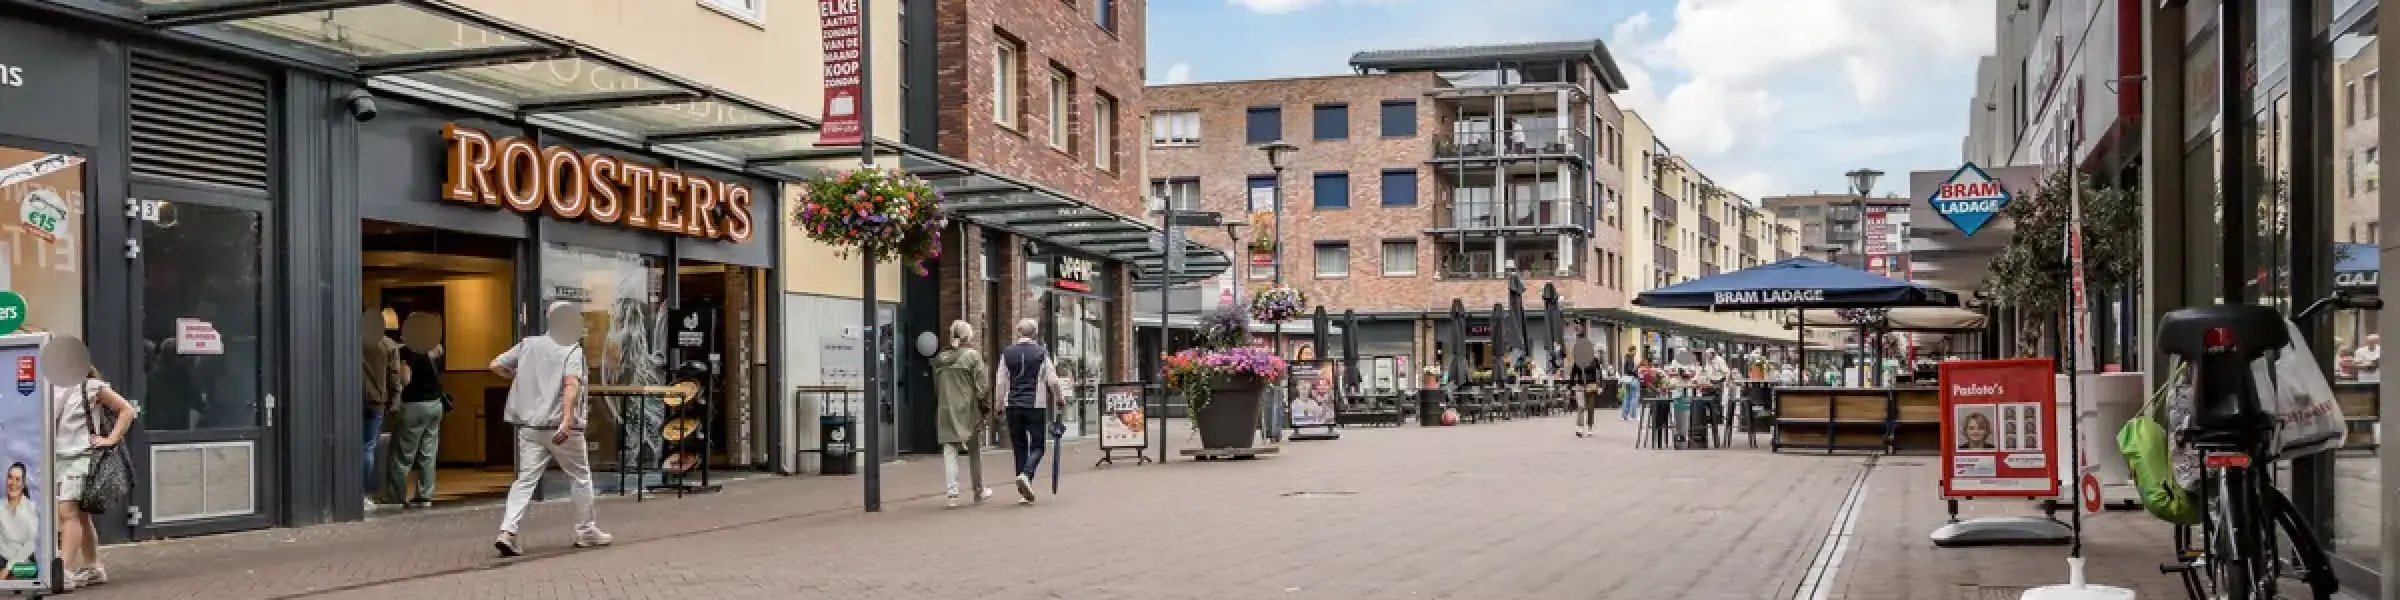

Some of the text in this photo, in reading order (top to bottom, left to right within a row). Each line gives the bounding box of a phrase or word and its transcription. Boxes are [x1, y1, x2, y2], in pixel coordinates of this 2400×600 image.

[821, 0, 857, 17] ELKE
[823, 27, 858, 39] ZONDAG
[824, 38, 859, 51] VAN DE
[824, 50, 859, 61] MAAND
[825, 62, 859, 77] KOOP
[443, 122, 753, 244] ROOSTER'S
[1940, 183, 2000, 199] BRAM
[1940, 199, 2000, 215] LADAGE
[28, 211, 57, 233] €15
[1715, 288, 1825, 305] BRAM LADAGE
[1953, 383, 2005, 397] Pasfoto's
